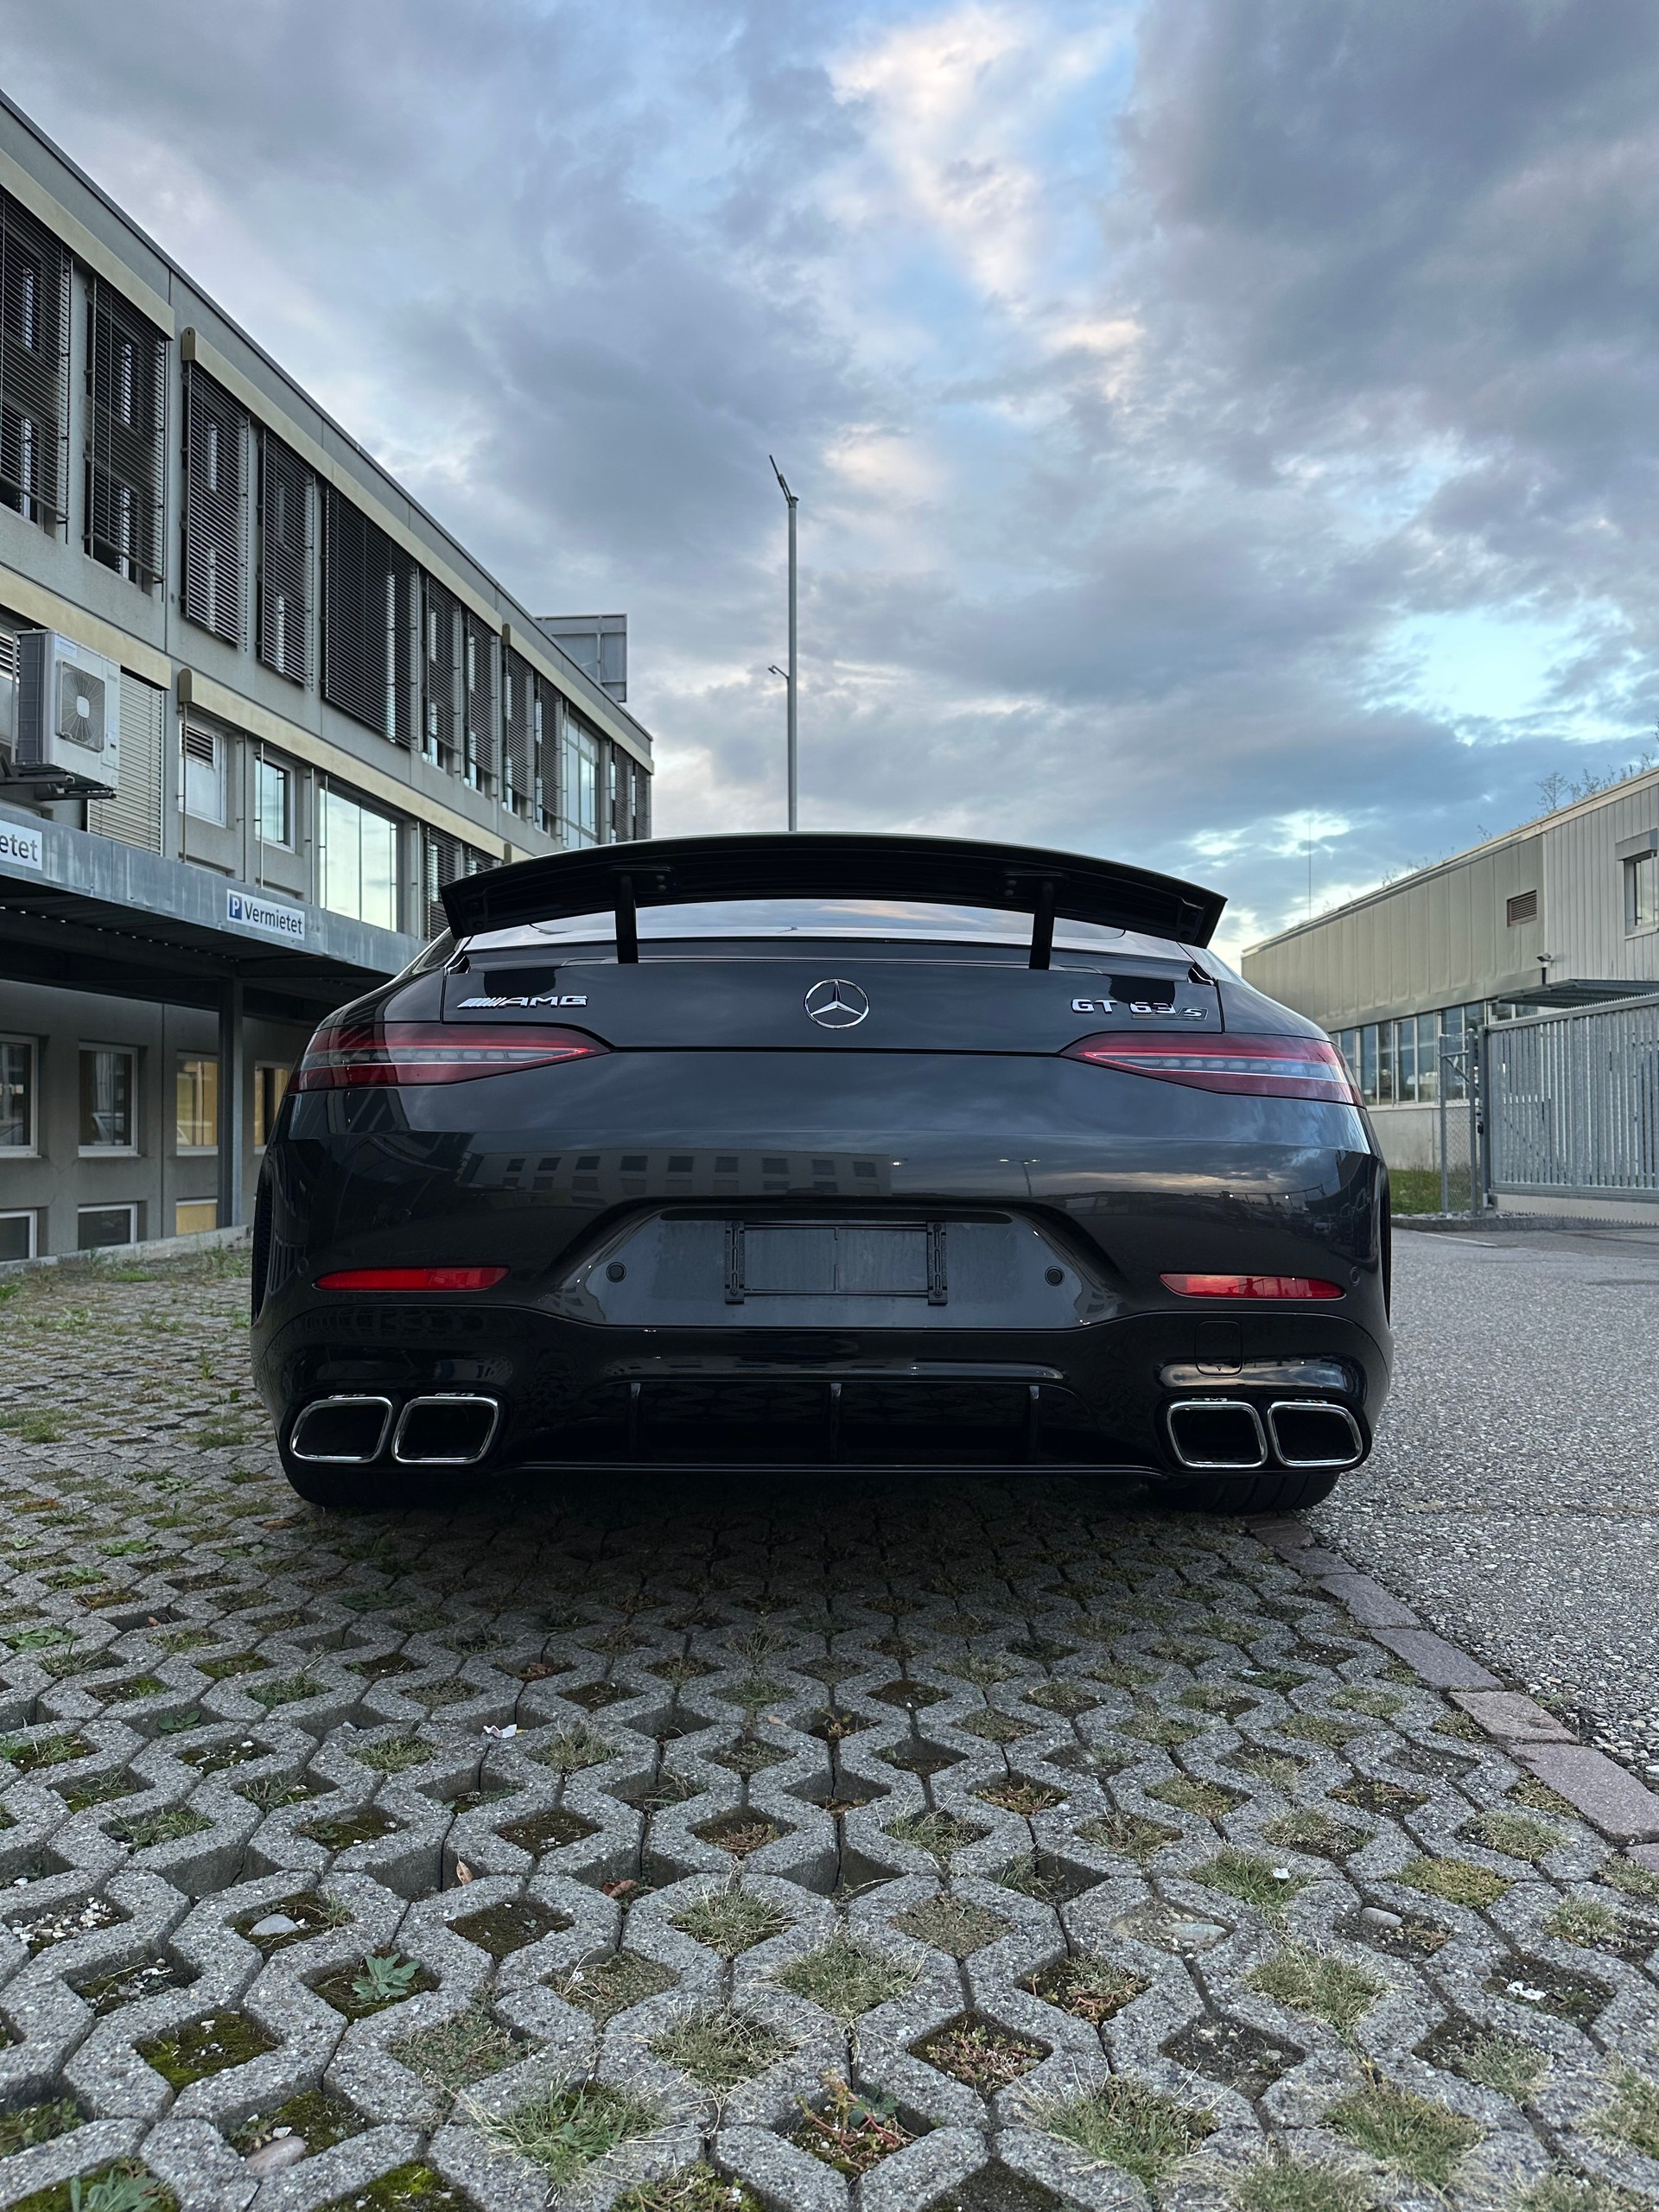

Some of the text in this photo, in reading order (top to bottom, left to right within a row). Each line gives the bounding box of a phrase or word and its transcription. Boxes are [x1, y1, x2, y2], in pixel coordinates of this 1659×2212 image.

[232, 896, 302, 934] P Vermietet
[497, 995, 588, 1009] AMG
[1071, 998, 1117, 1014] GT
[1129, 1001, 1177, 1015] 63
